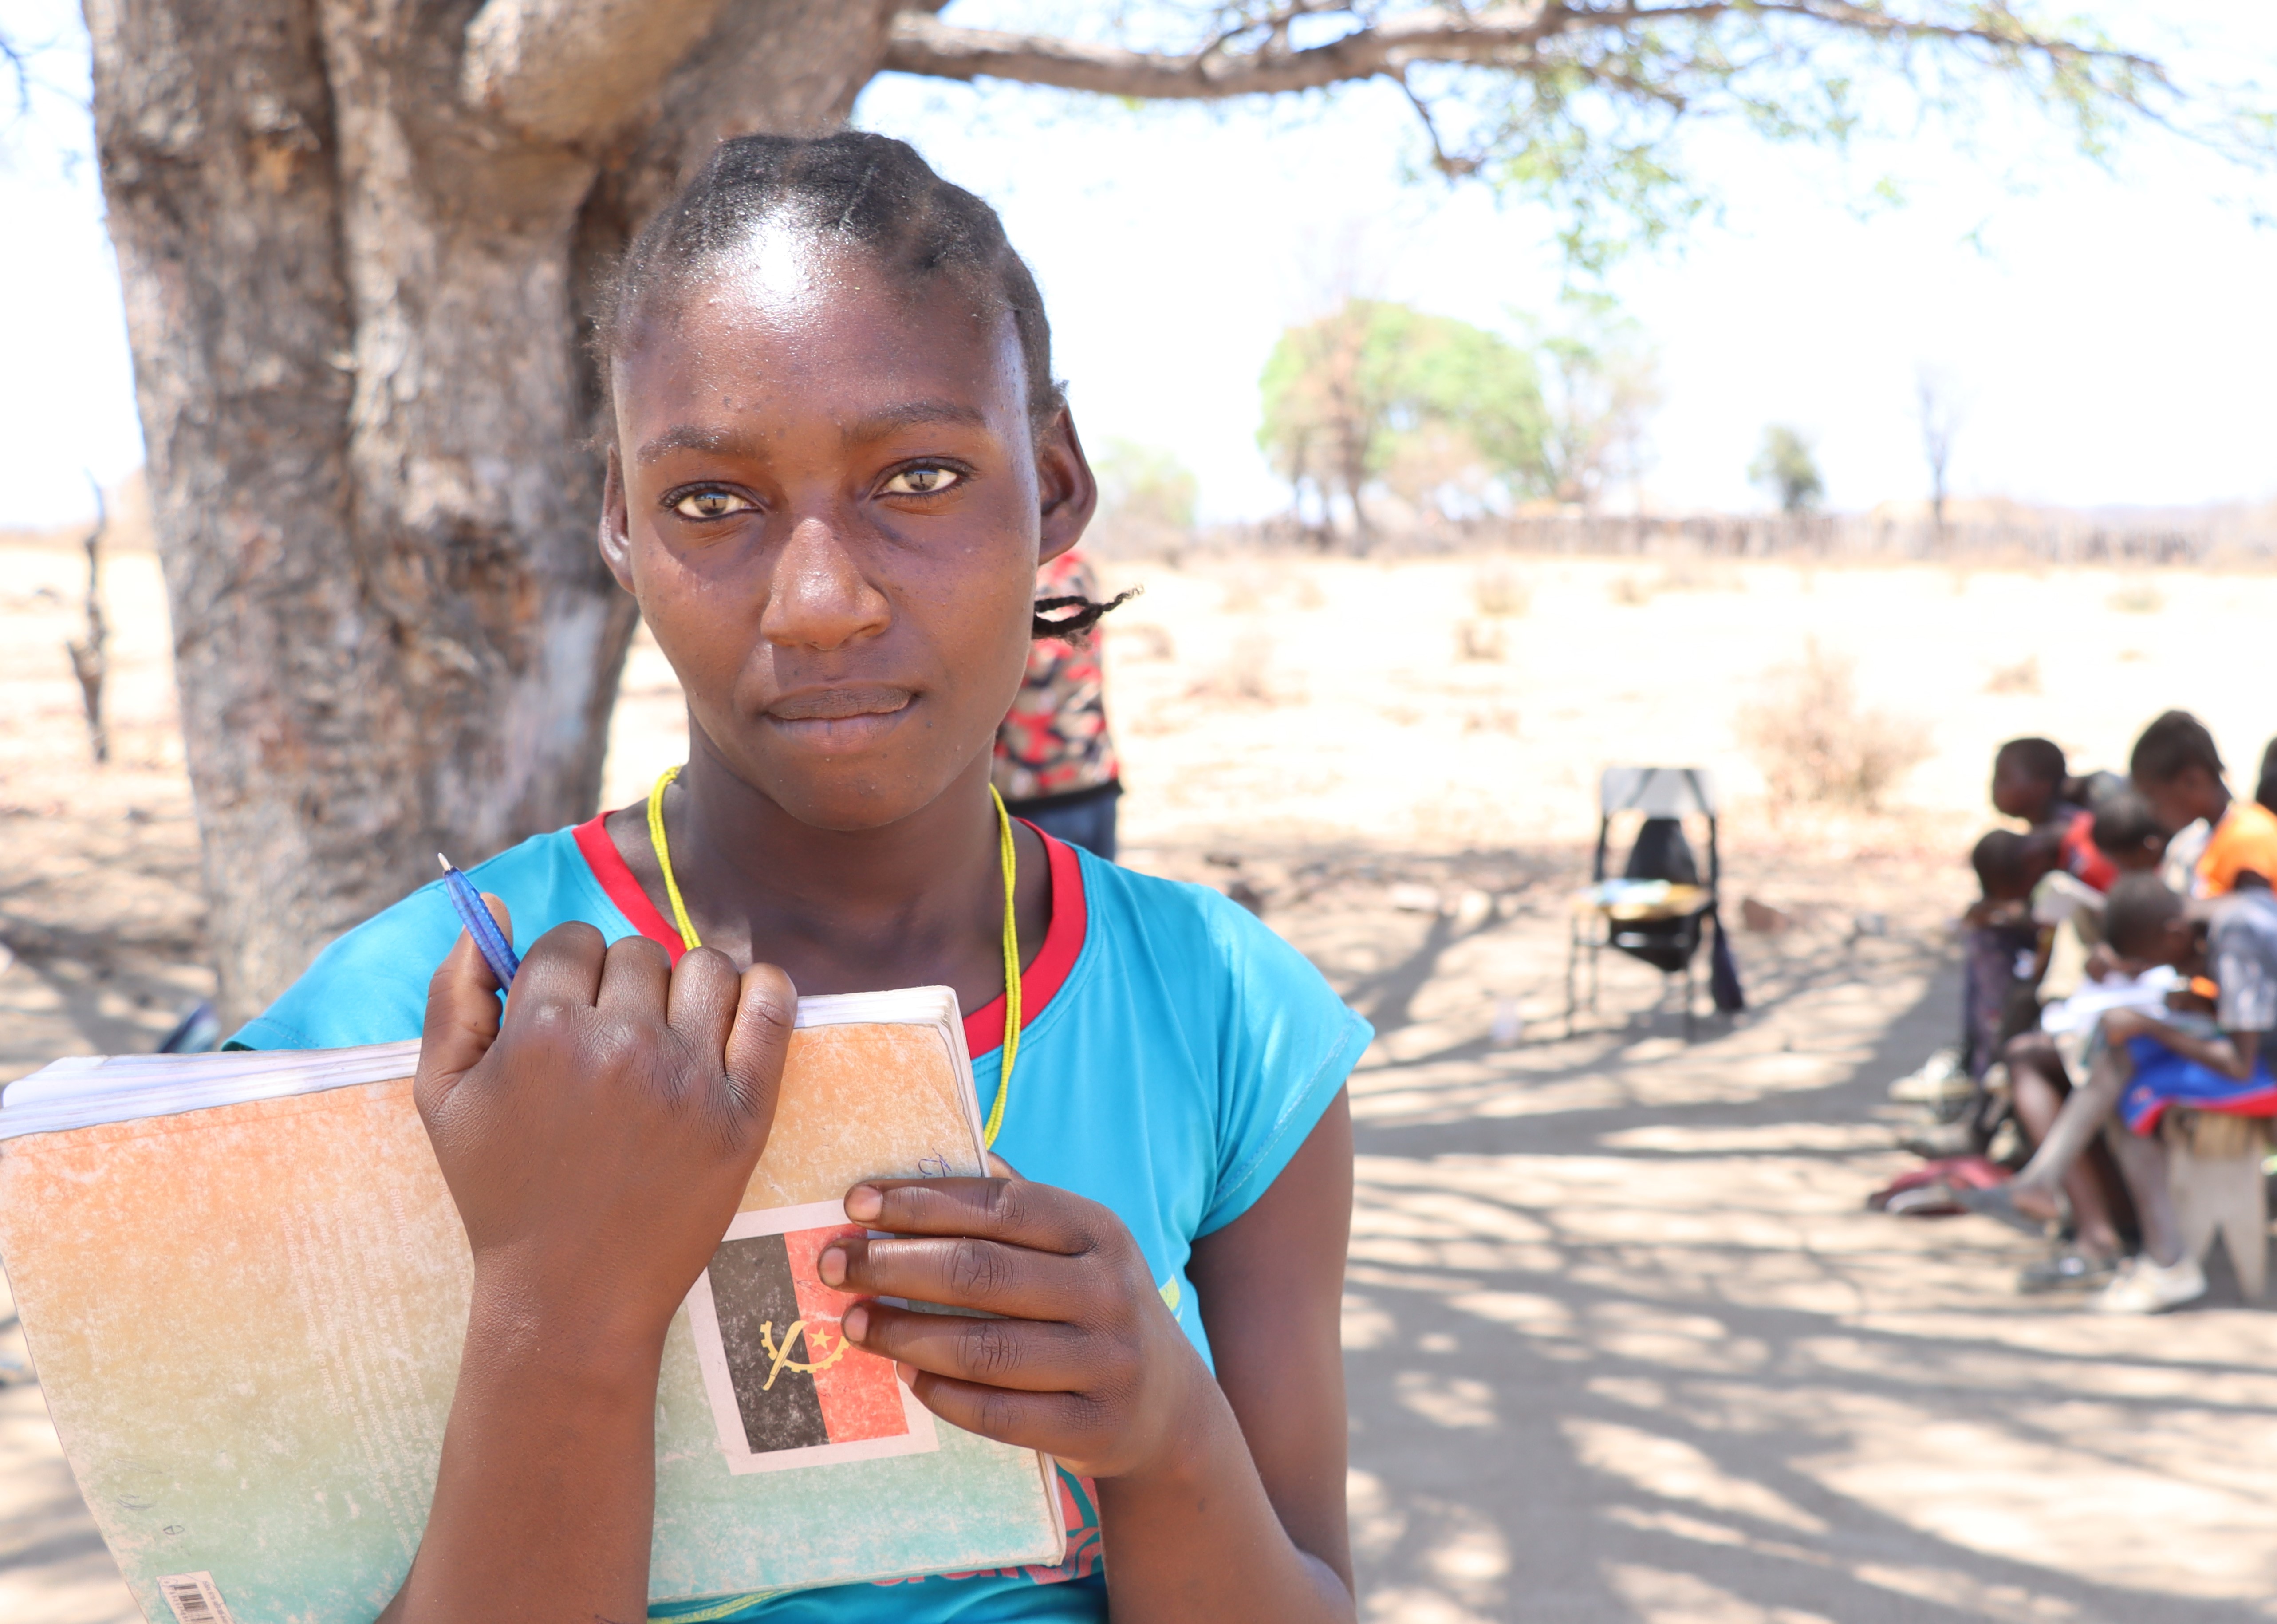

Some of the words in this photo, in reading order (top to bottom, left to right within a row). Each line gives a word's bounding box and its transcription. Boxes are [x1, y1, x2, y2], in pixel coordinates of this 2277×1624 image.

[296, 1204, 305, 1216] os
[390, 1188, 414, 1261] SIGNIFICADO
[300, 1221, 323, 1289] camponeses,
[331, 1198, 351, 1255] representa
[349, 1269, 369, 1322] continente
[279, 1206, 303, 1275] solidariedade
[297, 1279, 321, 1343] internacional
[317, 1353, 327, 1366] do
[367, 1192, 377, 1201] O
[382, 1261, 398, 1289] rubro
[390, 1295, 411, 1348] representa
[408, 1364, 425, 1399] sangue
[319, 1304, 342, 1351] produção
[325, 1248, 344, 1295] simboliza
[338, 1299, 347, 1311] os
[343, 1316, 366, 1382] trabalhadores
[376, 1308, 389, 1327] luta
[382, 1332, 393, 1345] de
[334, 1355, 353, 1392] agrícola
[354, 1415, 365, 1432] luta
[403, 1402, 422, 1438] nacional
